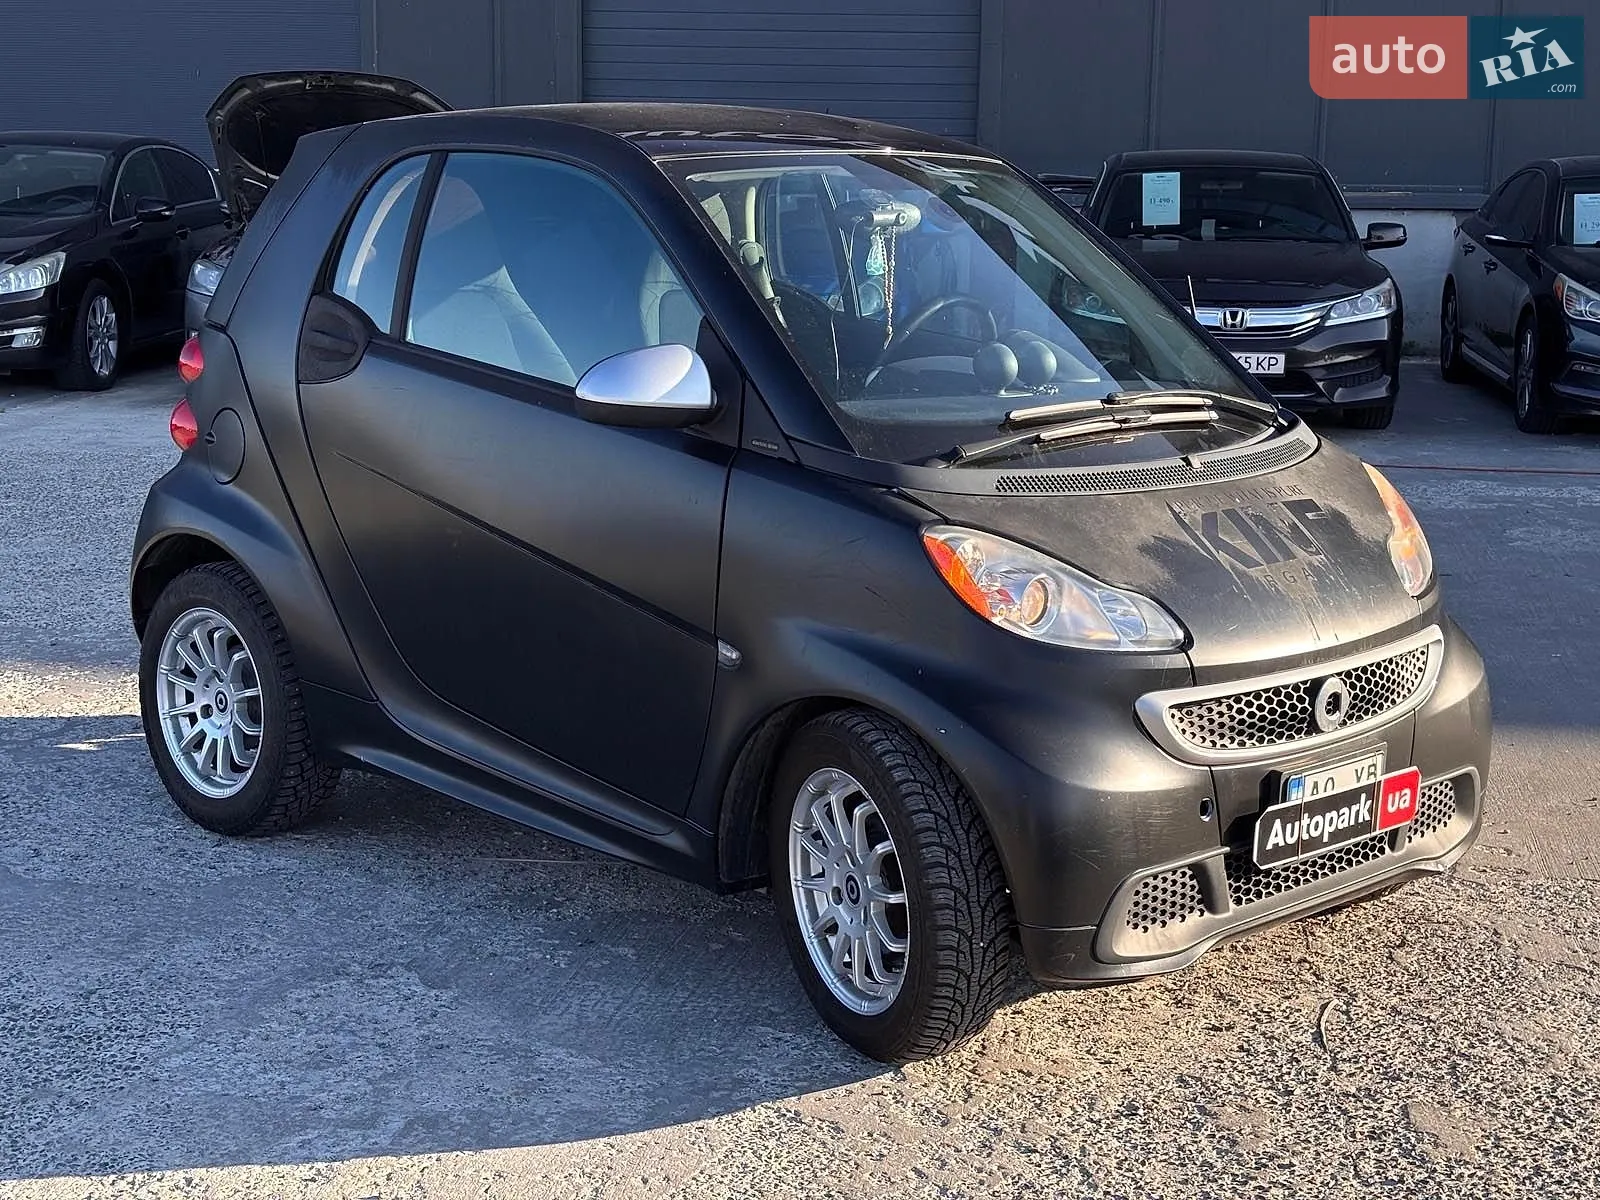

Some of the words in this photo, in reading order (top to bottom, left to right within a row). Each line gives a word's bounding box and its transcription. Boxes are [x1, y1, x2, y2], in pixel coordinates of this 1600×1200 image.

[1256, 356, 1279, 372] KP
[1265, 793, 1372, 851] Autopark
[1387, 788, 1411, 813] ua
